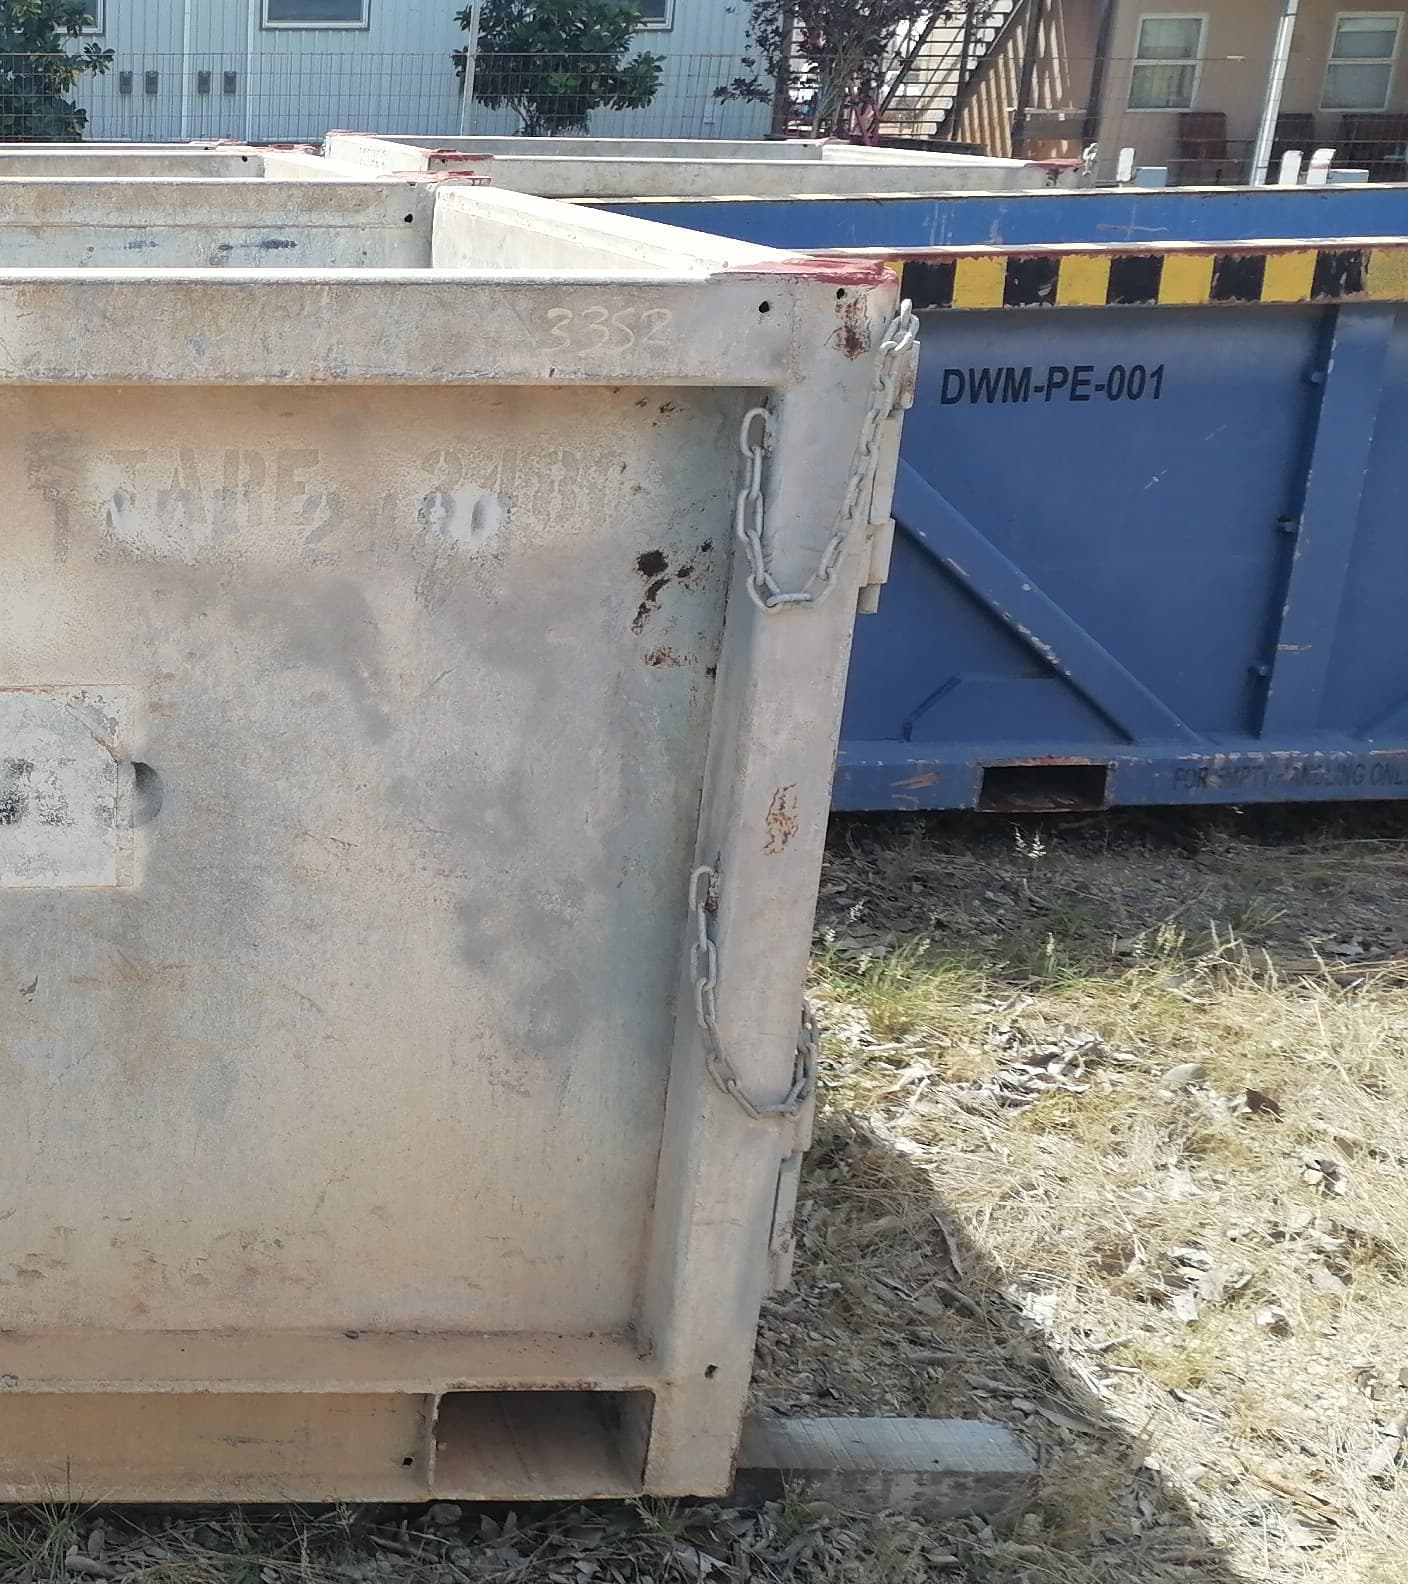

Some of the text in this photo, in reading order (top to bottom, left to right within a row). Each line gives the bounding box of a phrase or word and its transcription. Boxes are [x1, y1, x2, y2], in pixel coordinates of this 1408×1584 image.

[543, 305, 673, 354] 3352
[940, 363, 1166, 405] DWM-PE-001
[1173, 766, 1210, 791] FOR
[1368, 761, 1408, 785] ONL
